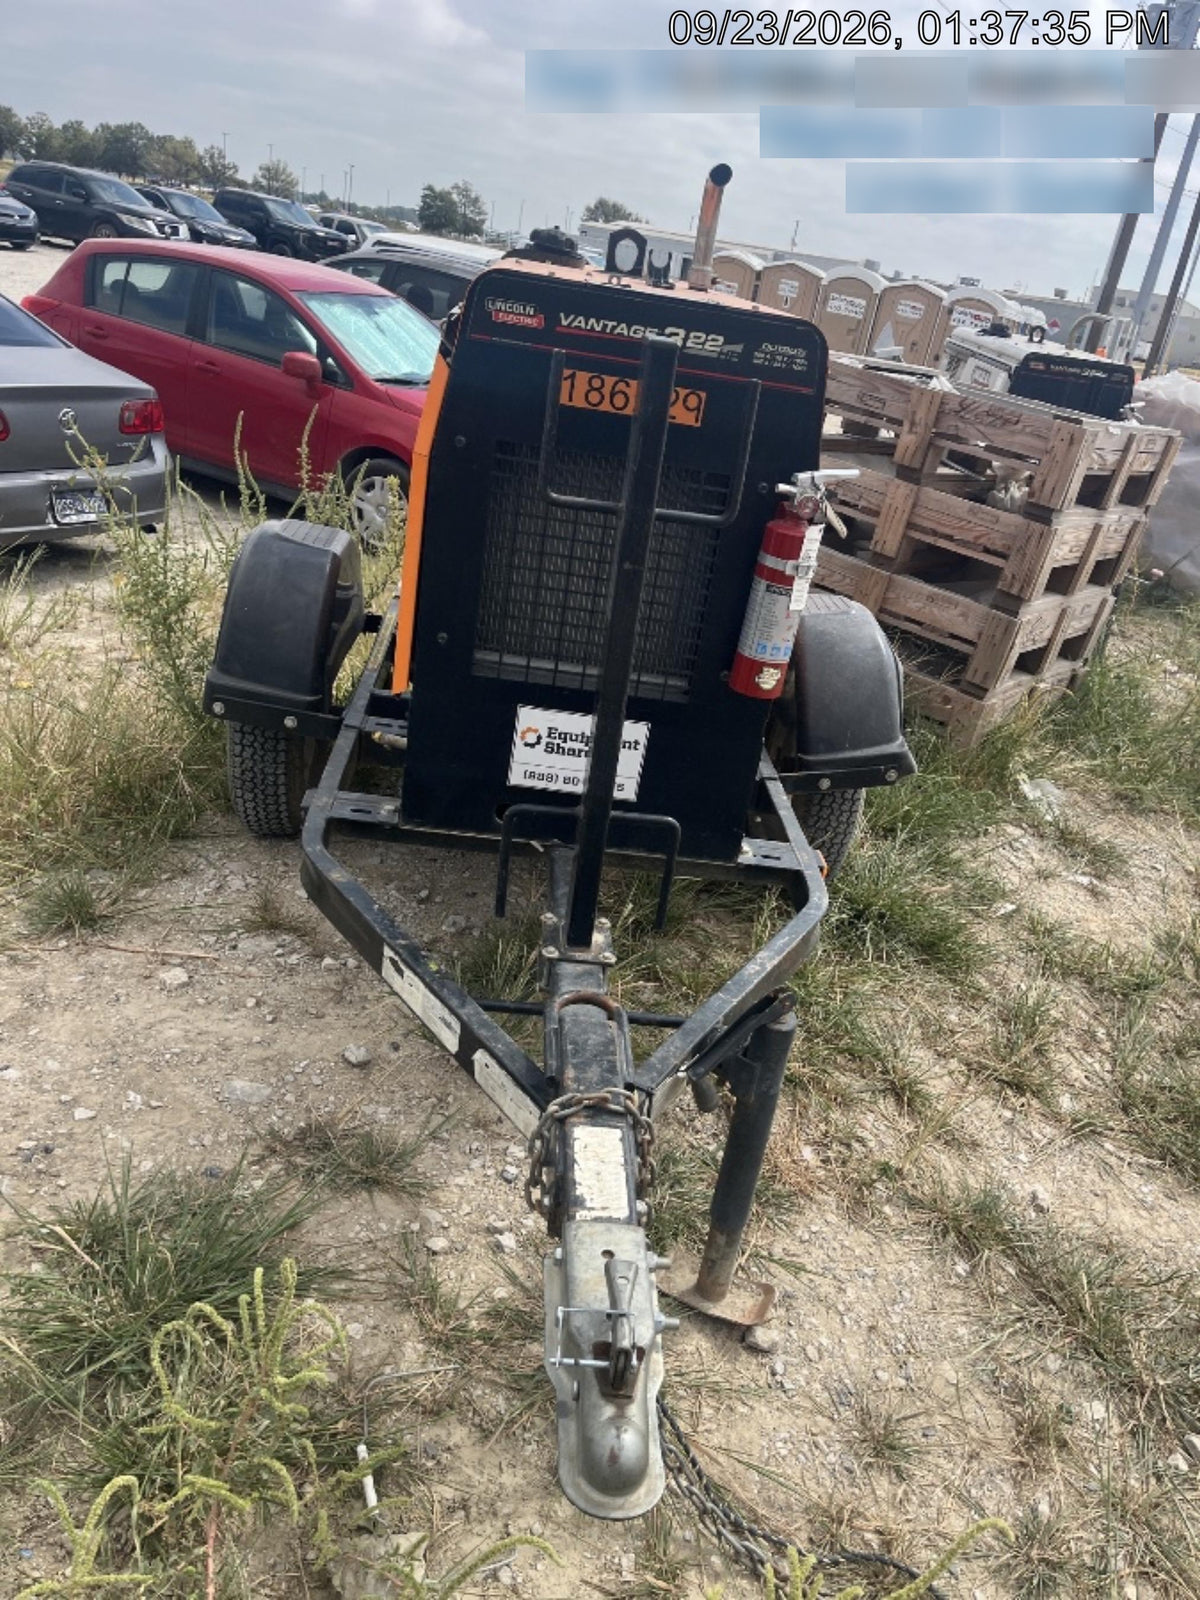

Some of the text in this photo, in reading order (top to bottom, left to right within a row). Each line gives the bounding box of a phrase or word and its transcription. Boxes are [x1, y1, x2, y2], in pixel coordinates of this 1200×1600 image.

[486, 298, 537, 317] LINCOLN
[559, 312, 659, 339] VANTAGE
[562, 370, 703, 424] 1869
[545, 726, 641, 751] Equipnt
